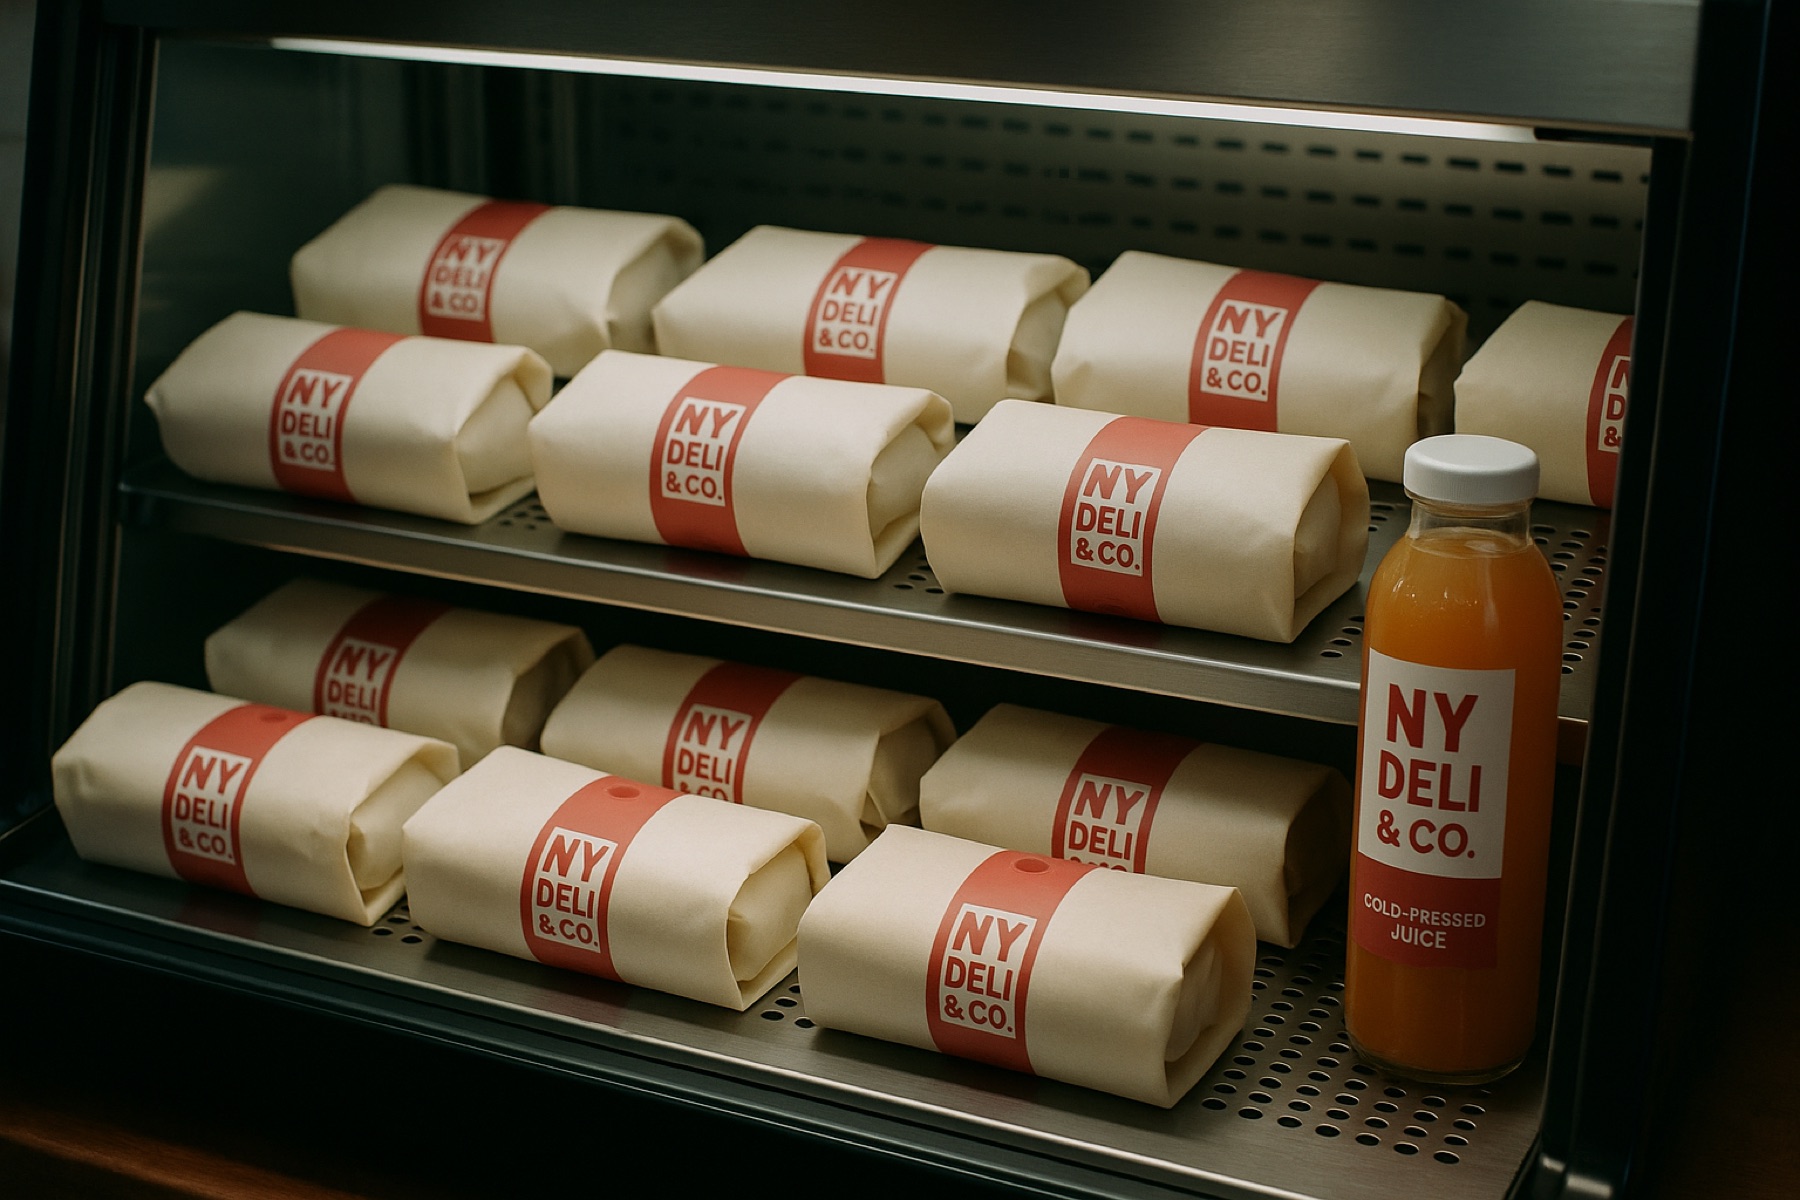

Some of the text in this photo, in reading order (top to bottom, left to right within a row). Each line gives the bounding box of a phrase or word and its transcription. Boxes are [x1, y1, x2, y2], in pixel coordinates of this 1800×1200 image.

[831, 271, 889, 300] NY
[822, 300, 877, 326] DELI
[1217, 305, 1279, 338] NY
[819, 328, 833, 347] &
[1208, 336, 1270, 368] DELI
[287, 375, 343, 409] NY
[1207, 367, 1266, 396] & CO.
[282, 410, 332, 439] DELI
[675, 404, 737, 439] NY
[667, 438, 723, 471] DELI
[666, 471, 723, 500] & CO.
[1083, 464, 1153, 504] NY
[1076, 502, 1141, 539] DELI
[1076, 538, 1141, 570] & CO.
[334, 644, 390, 682] NY
[328, 680, 376, 712] DELI
[684, 711, 744, 751] NY
[1387, 683, 1479, 753] NY
[183, 755, 243, 795] NY
[677, 747, 732, 785] DELI
[1378, 749, 1482, 813] DELI
[176, 793, 227, 830] DELI
[1074, 780, 1144, 825] NY
[179, 827, 195, 848] &
[1069, 820, 1132, 861] DELI
[1377, 809, 1475, 859] & CO.
[542, 834, 610, 883] NY
[537, 878, 595, 919] DELI
[1364, 893, 1486, 928] COLD-PRESSED
[539, 914, 599, 947] & CO.
[952, 911, 1028, 963] NY
[1391, 923, 1447, 949] JUICE
[944, 956, 1013, 1001] DELI
[944, 994, 1013, 1032] & CO.
